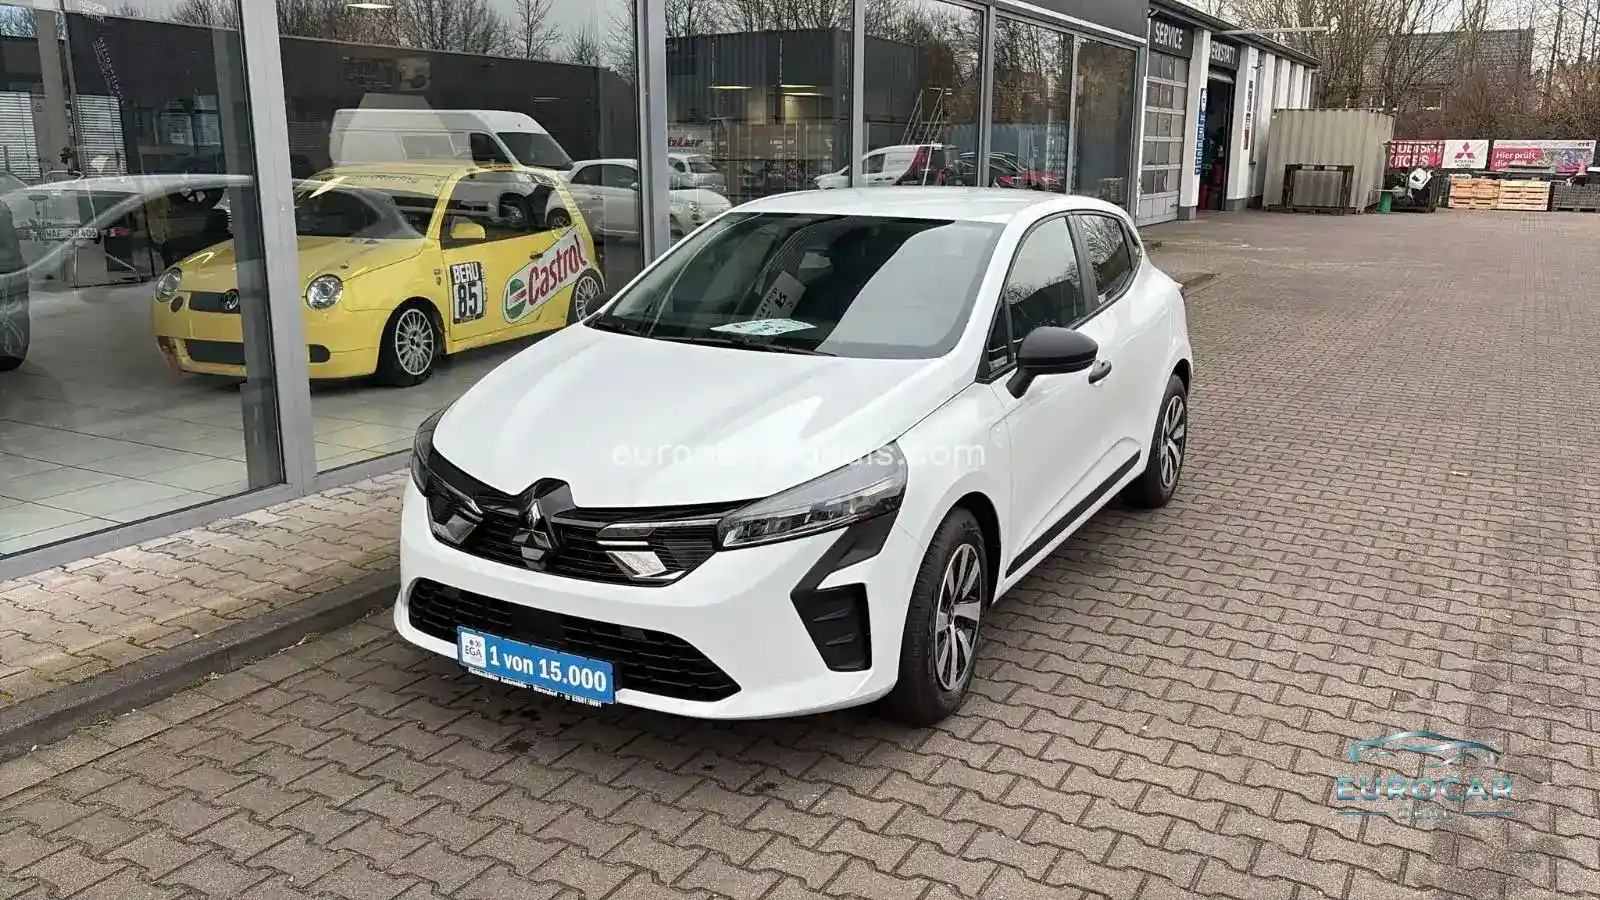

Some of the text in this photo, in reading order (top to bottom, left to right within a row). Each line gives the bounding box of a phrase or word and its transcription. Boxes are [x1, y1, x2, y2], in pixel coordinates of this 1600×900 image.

[1155, 21, 1183, 50] SERVICE
[1210, 40, 1236, 65] ERKSTATT
[1495, 151, 1536, 160] Hier prüft
[452, 262, 479, 284] BERU
[528, 234, 587, 306] Castrol
[457, 281, 478, 318] 85
[464, 646, 483, 657] EGA
[489, 645, 606, 693] 1 von 15.000
